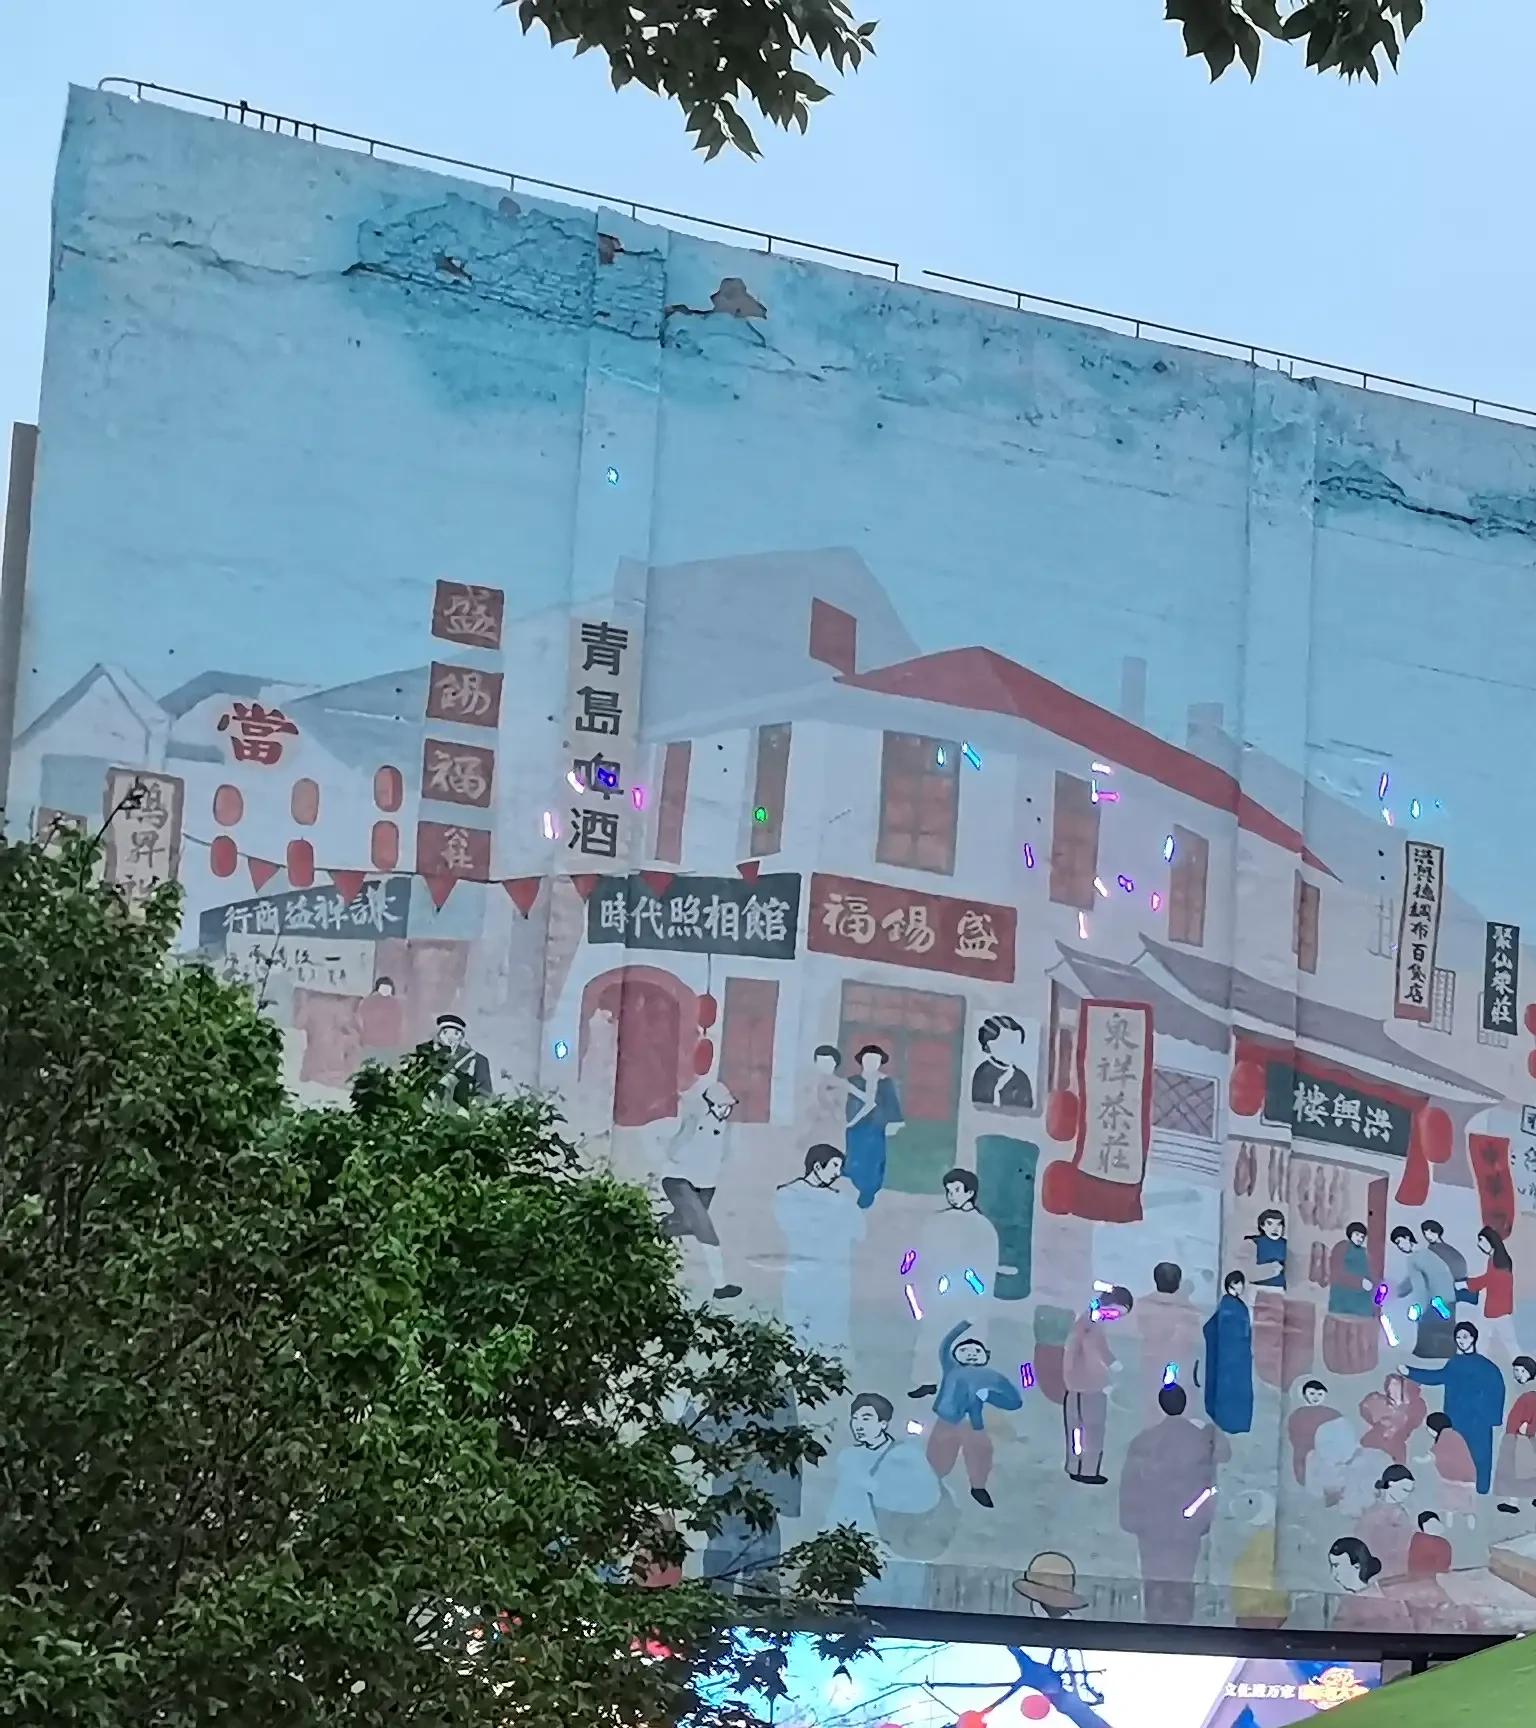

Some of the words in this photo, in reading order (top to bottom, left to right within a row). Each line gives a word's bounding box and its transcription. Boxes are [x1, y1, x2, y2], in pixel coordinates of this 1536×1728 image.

[217, 702, 299, 765] 當
[600, 892, 790, 942] 時代照相館
